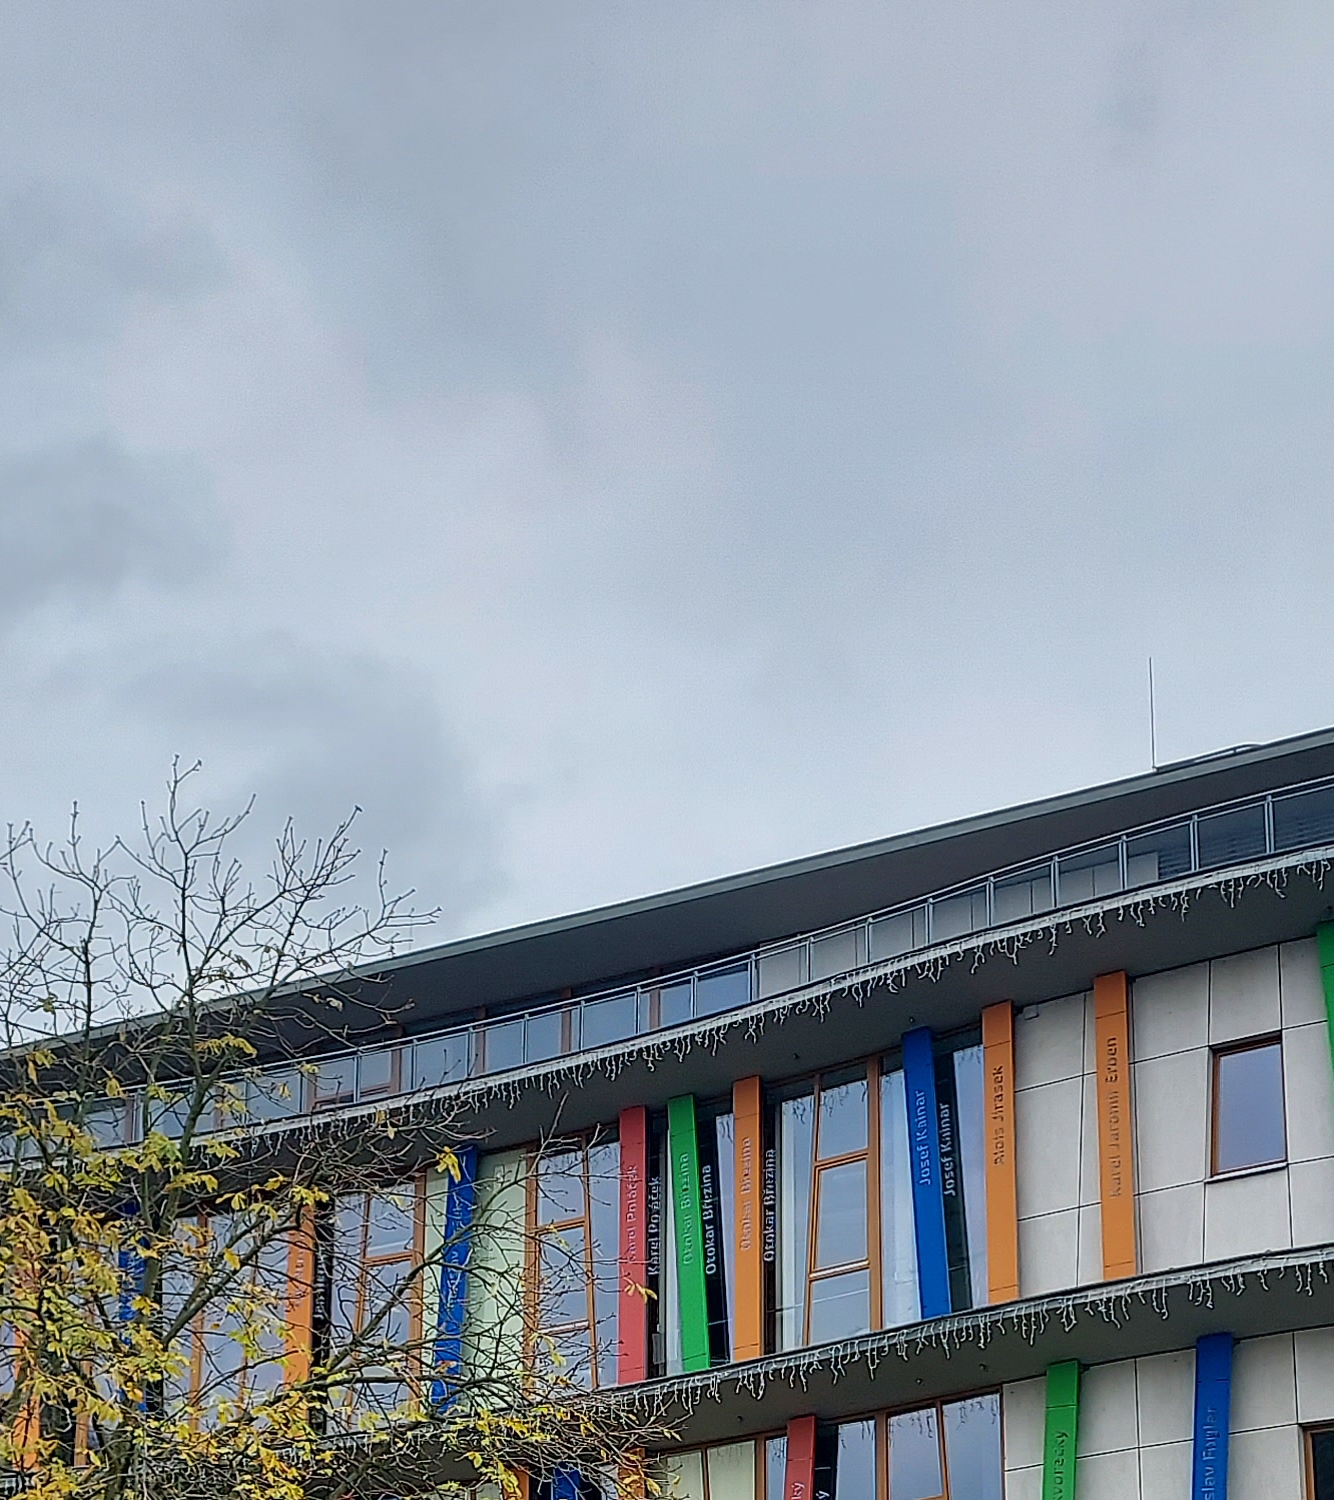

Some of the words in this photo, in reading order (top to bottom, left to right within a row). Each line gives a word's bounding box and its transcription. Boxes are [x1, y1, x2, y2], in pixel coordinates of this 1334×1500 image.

[1104, 1036, 1118, 1083] Erben
[914, 1089, 929, 1143] Kainar
[916, 1143, 932, 1185] Josef
[940, 1154, 956, 1197] Josef
[701, 1223, 717, 1275] Otokar
[763, 1209, 776, 1262] Otokar
